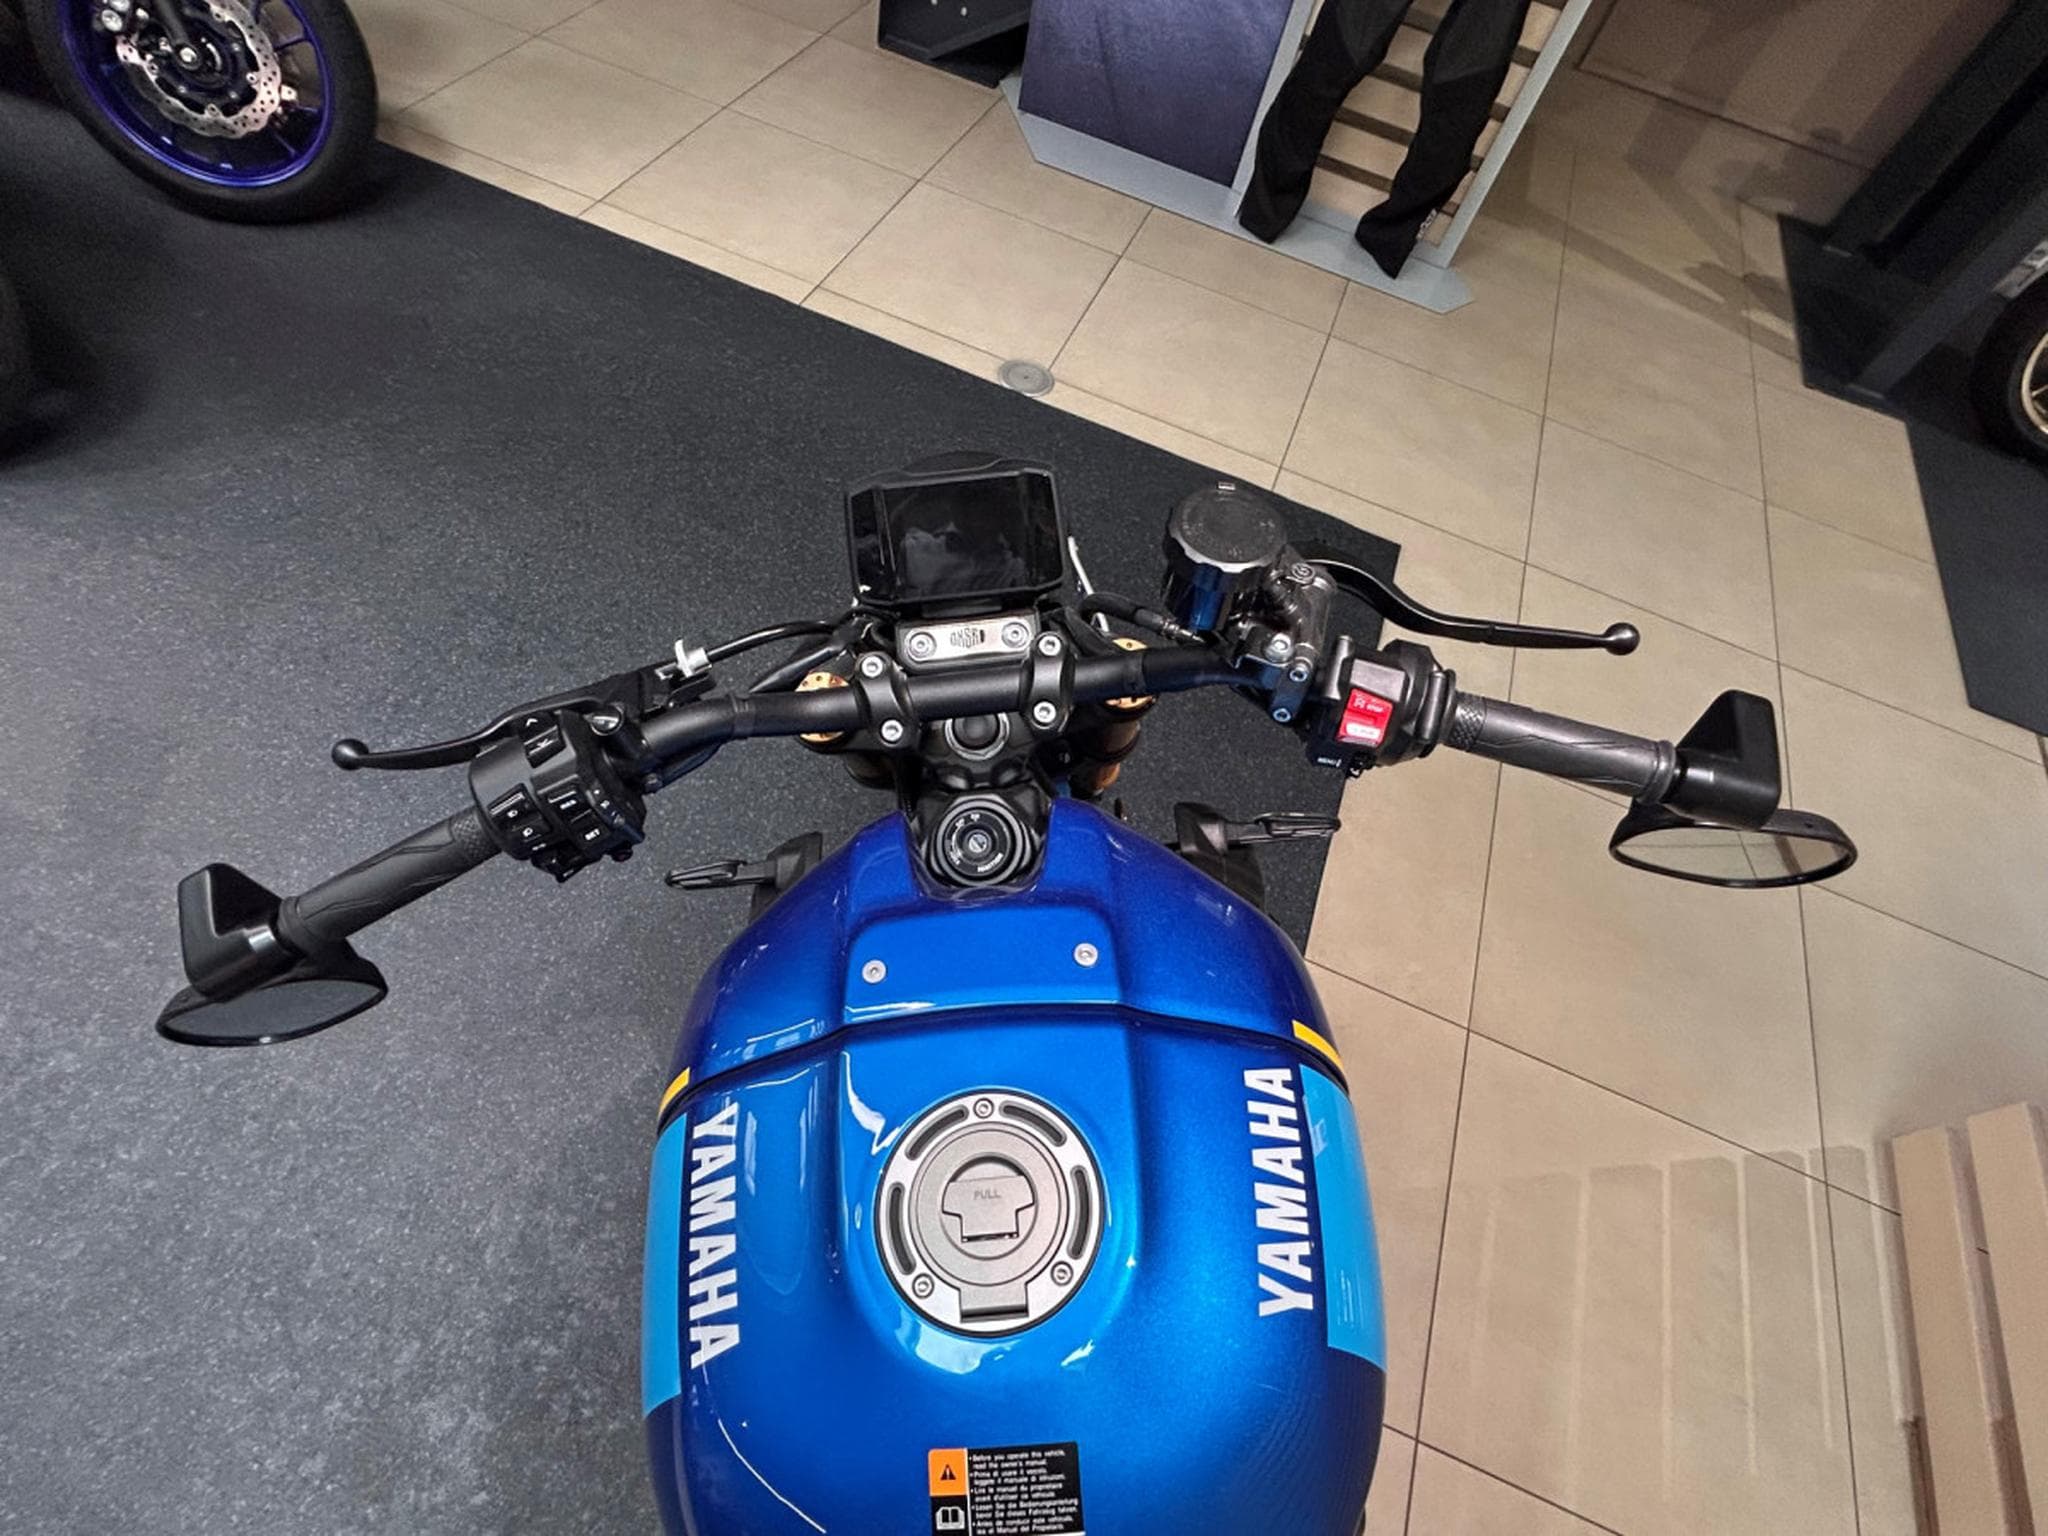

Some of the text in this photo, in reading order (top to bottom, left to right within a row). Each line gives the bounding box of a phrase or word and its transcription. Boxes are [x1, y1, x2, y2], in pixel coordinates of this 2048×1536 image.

[688, 1101, 741, 1370] YAMAHA
[973, 1188, 1003, 1200] PULL
[1243, 1068, 1314, 1317] YAMAHA
